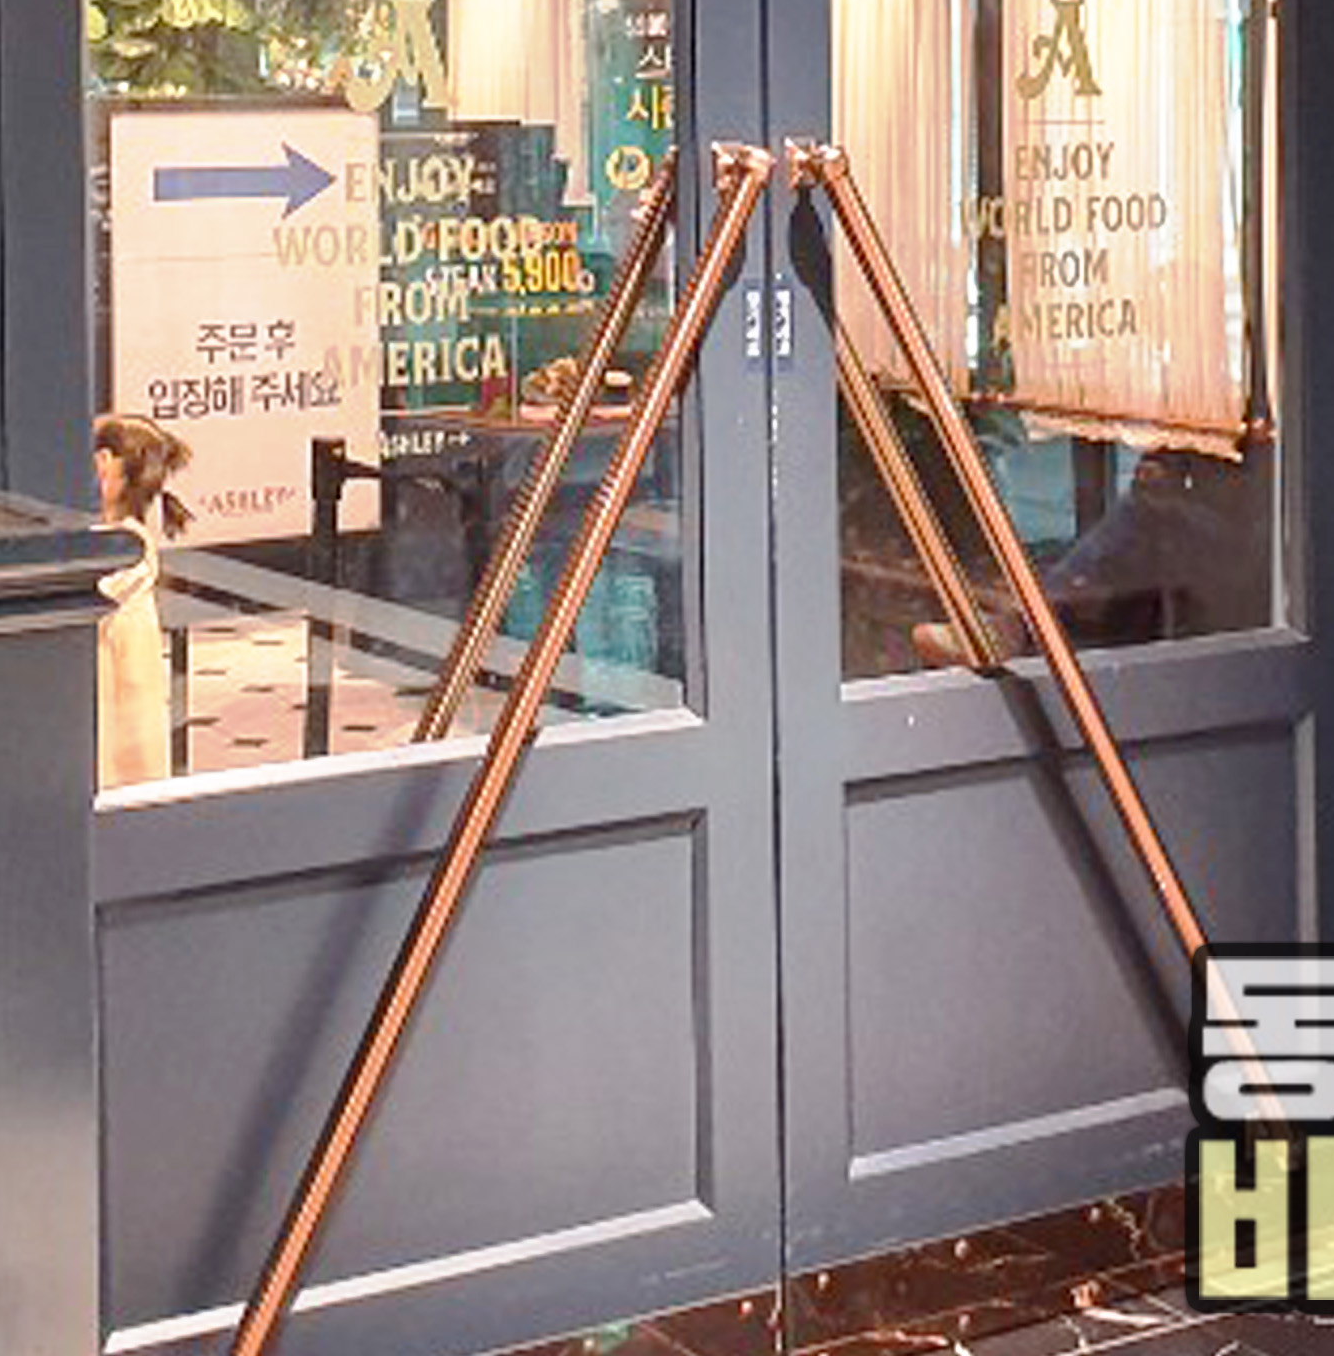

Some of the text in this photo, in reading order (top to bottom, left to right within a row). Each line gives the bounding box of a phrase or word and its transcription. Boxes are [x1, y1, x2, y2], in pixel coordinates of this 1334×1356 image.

[344, 152, 475, 203] ENJOY
[1015, 142, 1114, 181] ENJOY
[961, 193, 1167, 241] WORLD FOOD
[271, 219, 422, 268] WORLD
[438, 214, 543, 262] FOOD
[1020, 249, 1108, 289] FROM
[353, 280, 471, 326] FROM
[992, 298, 1138, 345] AMERICA
[196, 319, 296, 363] 주문 후
[322, 333, 508, 388] AMERICA
[149, 370, 341, 419] 입장해 주세요
